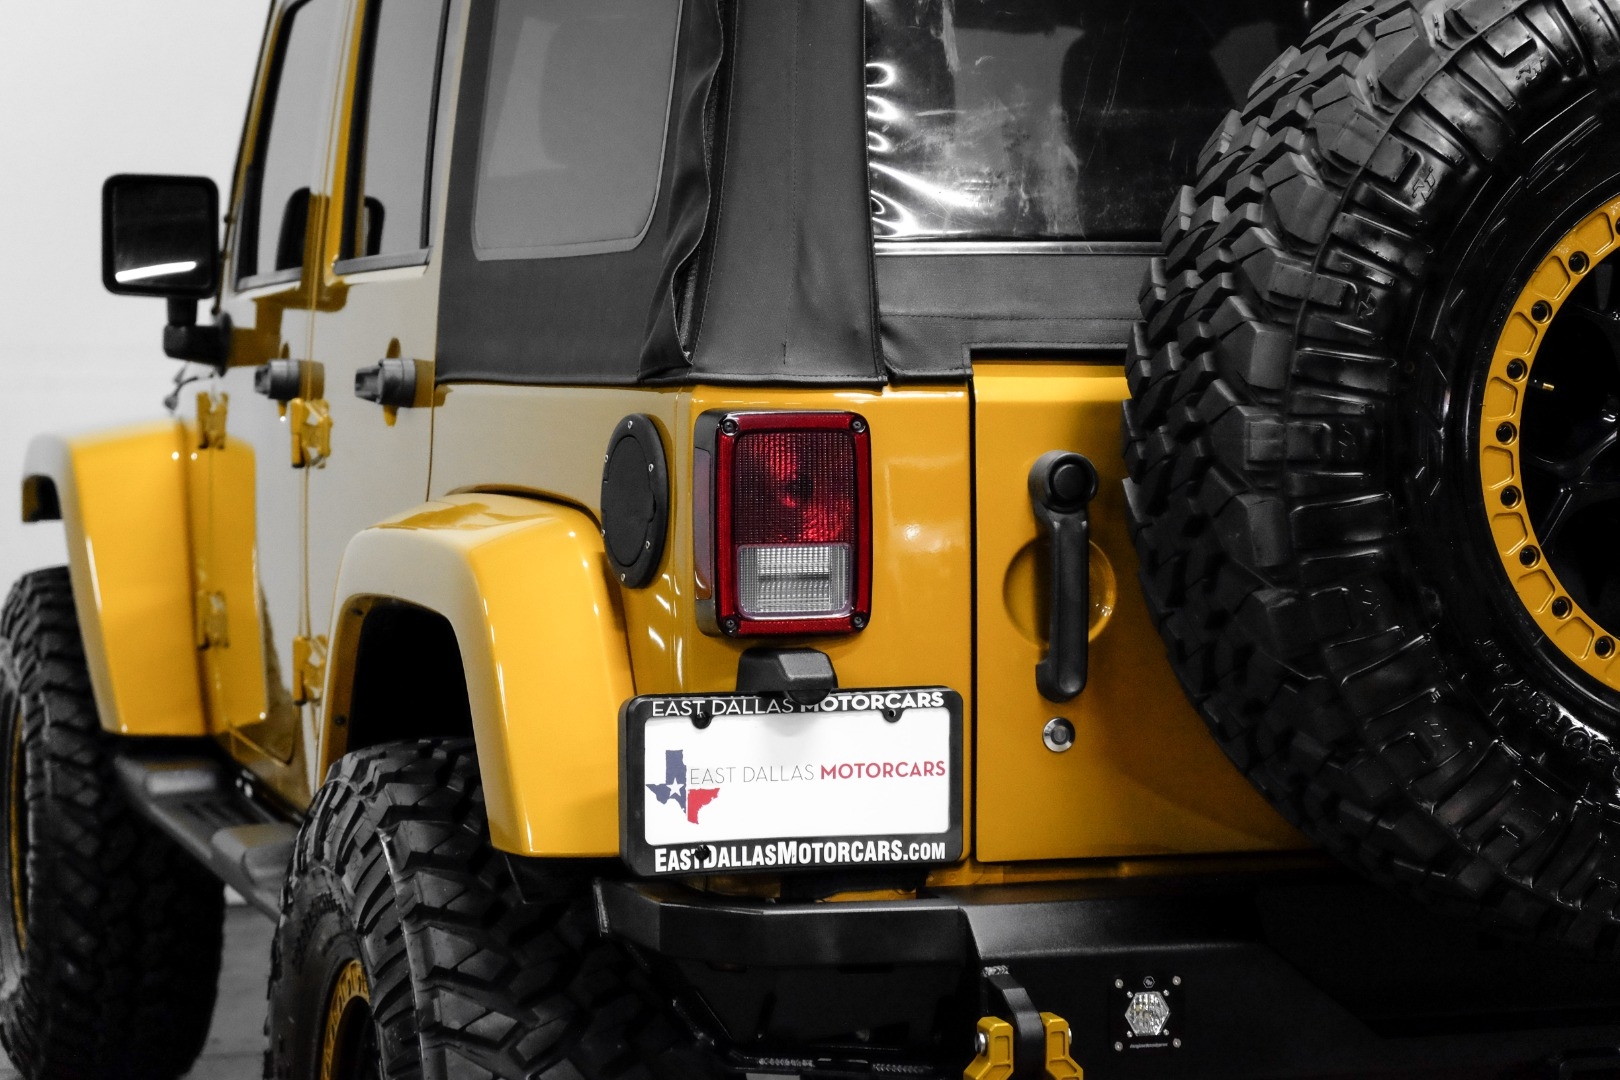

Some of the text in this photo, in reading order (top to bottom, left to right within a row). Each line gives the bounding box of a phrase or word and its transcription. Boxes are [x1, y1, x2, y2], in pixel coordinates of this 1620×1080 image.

[652, 700, 706, 717] EAST
[711, 698, 794, 716] DALLAS
[690, 760, 946, 785] EAST DALLAS MOTORCARS
